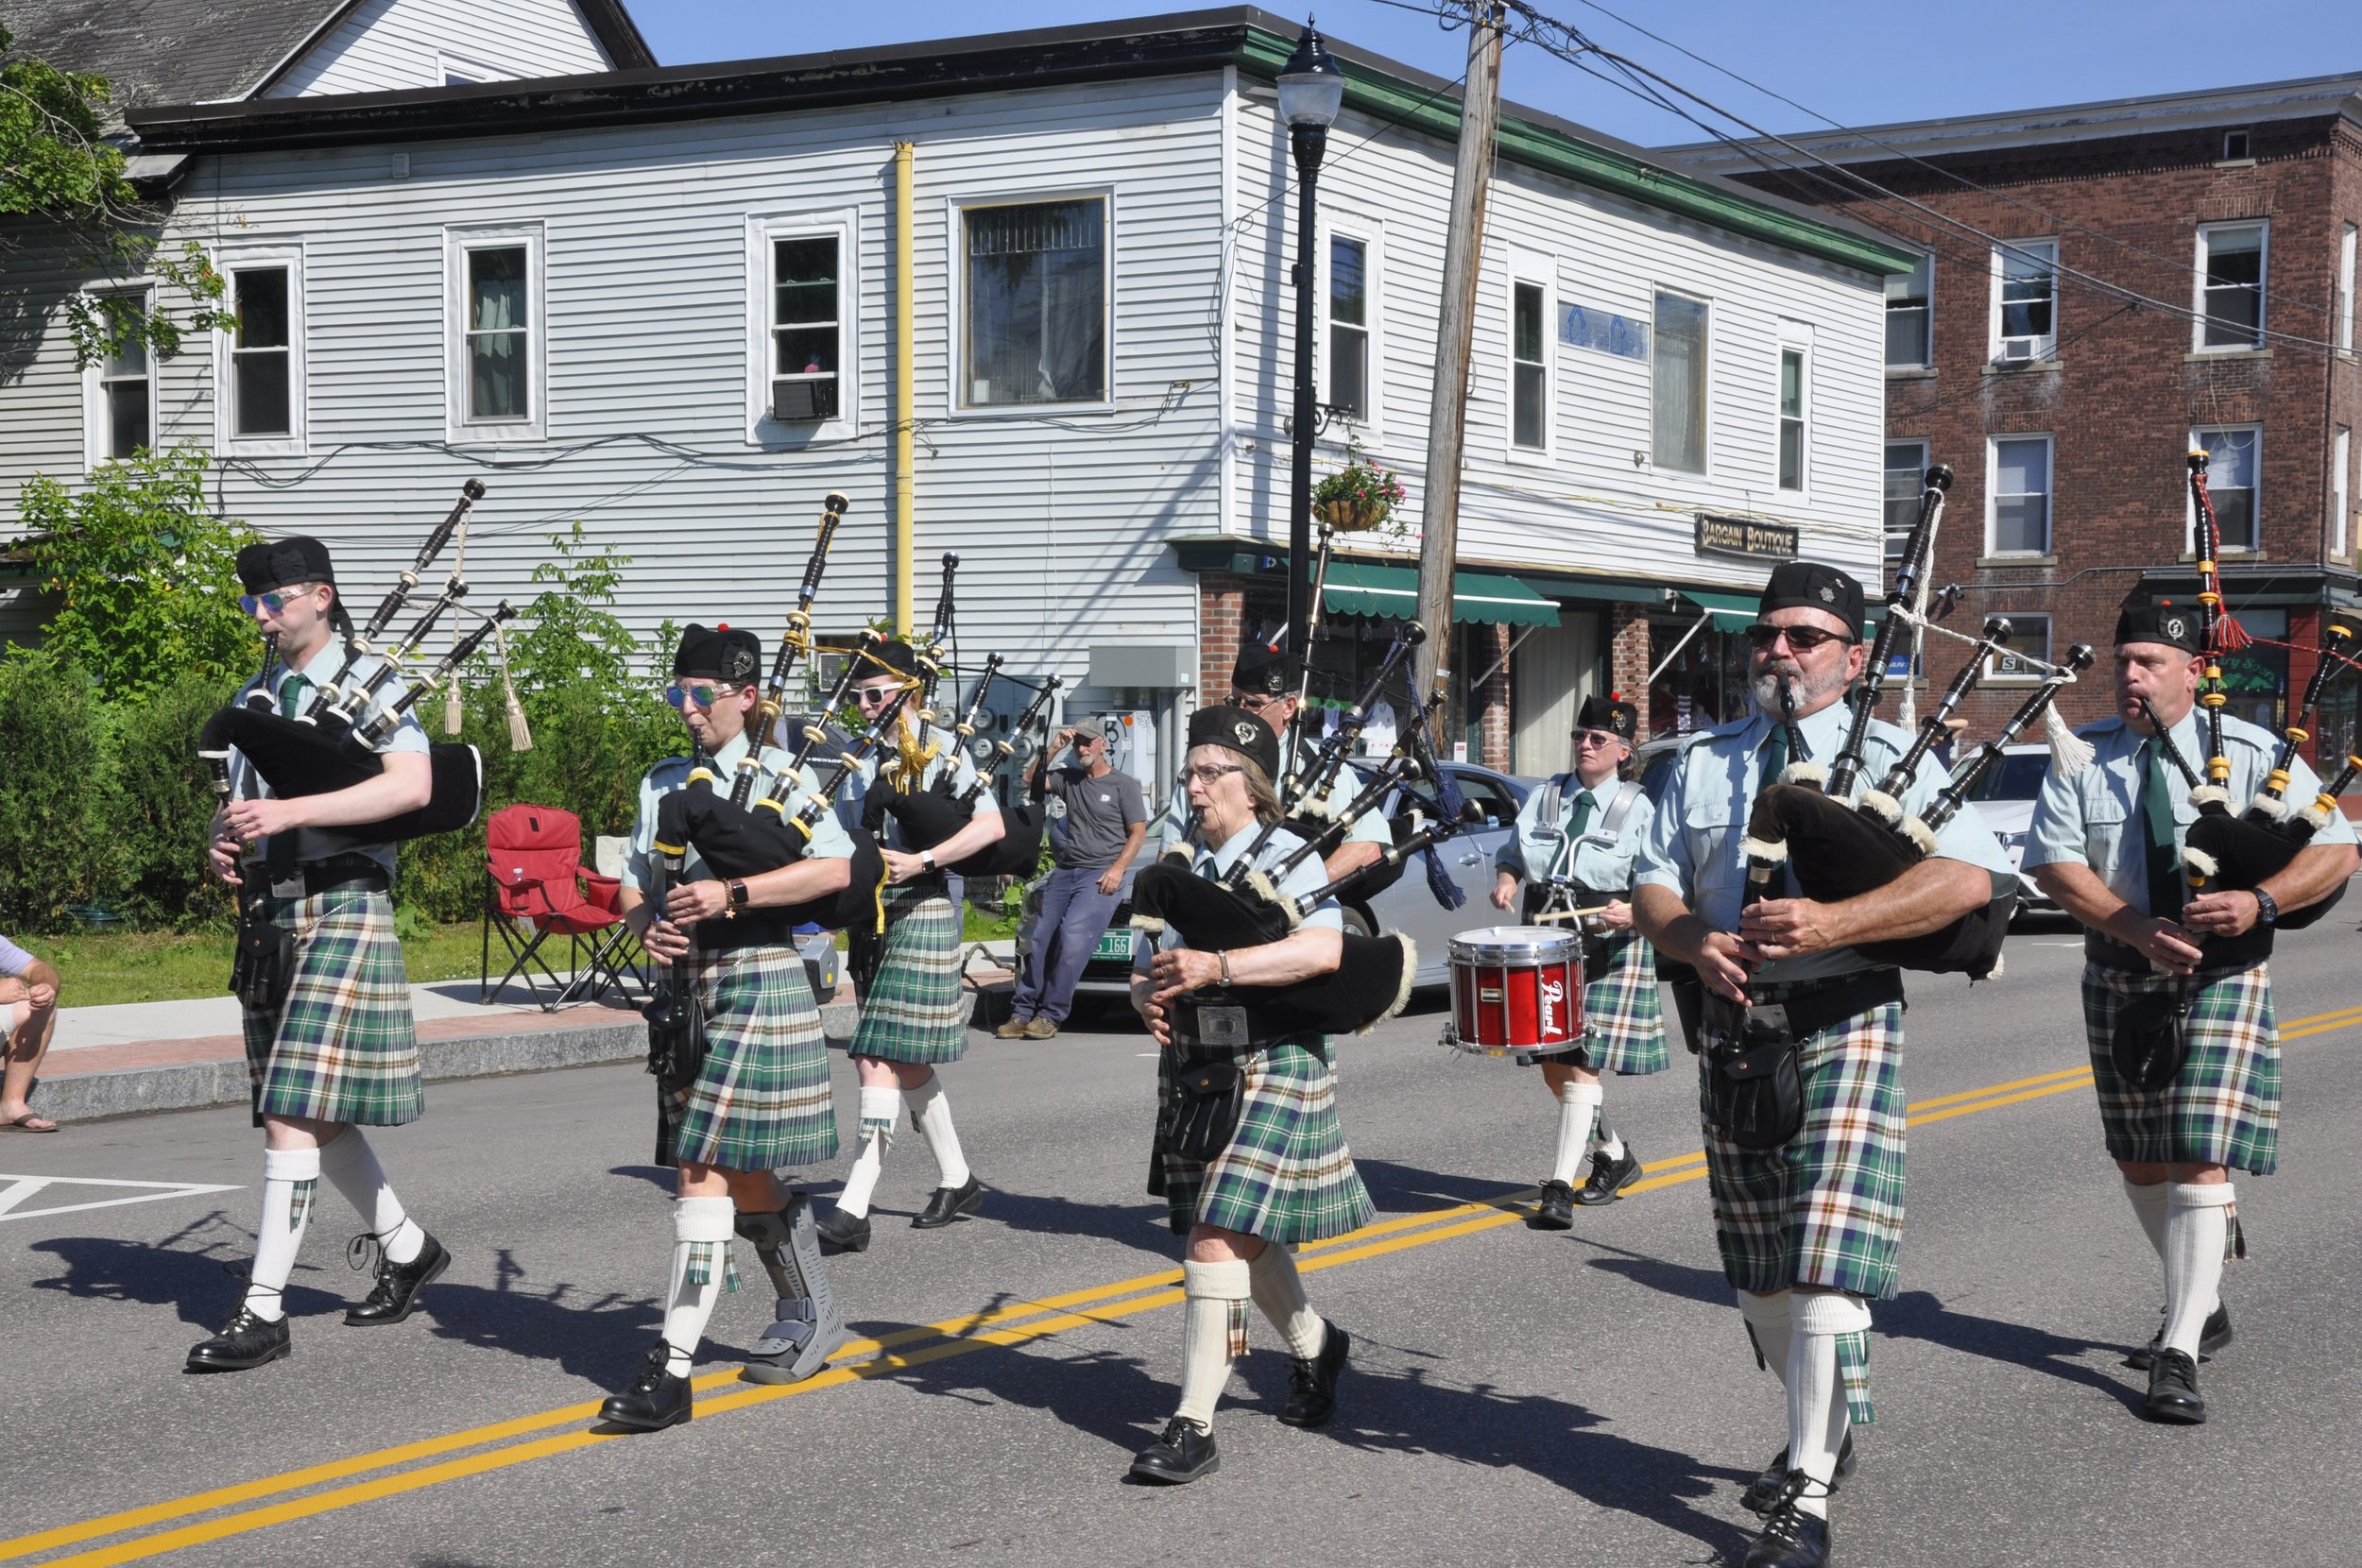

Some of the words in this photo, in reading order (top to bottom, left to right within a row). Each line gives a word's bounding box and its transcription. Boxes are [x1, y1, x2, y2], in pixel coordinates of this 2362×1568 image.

[1703, 520, 1742, 547] BARGAIN
[1747, 526, 1793, 554] BOUTIQUE
[1108, 938, 1127, 953] 166
[1541, 979, 1564, 1035] Pearl
